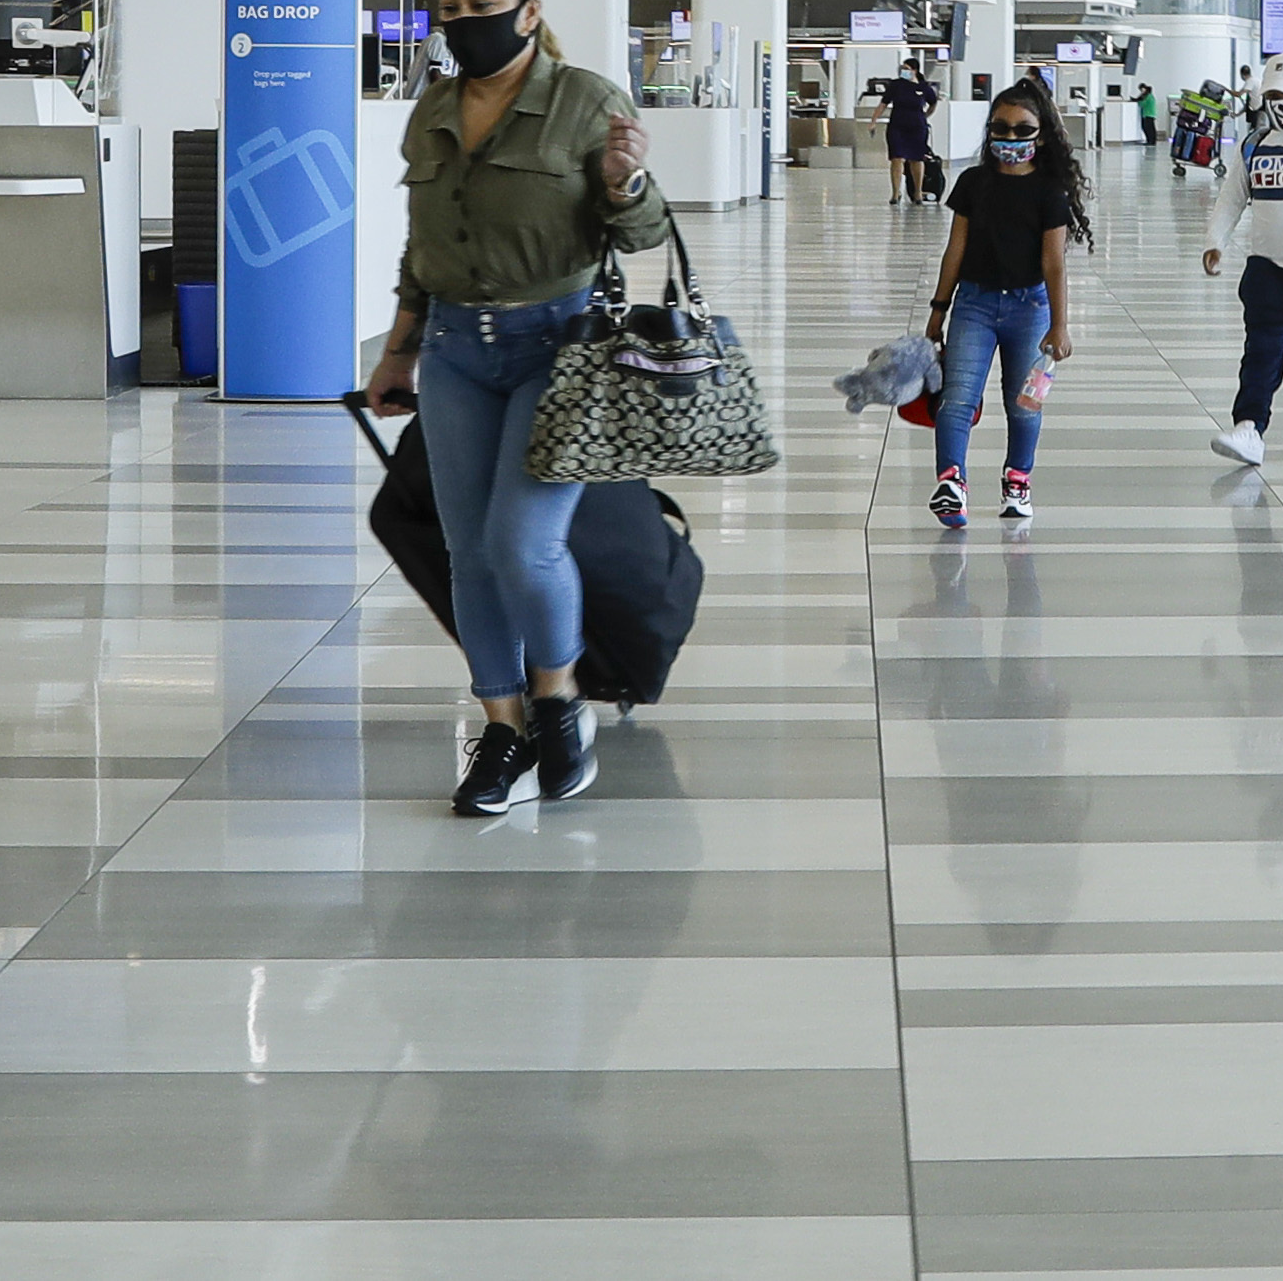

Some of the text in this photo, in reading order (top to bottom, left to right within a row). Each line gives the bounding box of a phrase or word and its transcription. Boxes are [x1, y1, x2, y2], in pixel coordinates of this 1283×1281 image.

[237, 5, 320, 19] BAG DROP
[237, 42, 245, 53] 2
[253, 71, 270, 79] Drop
[254, 80, 268, 88] bags
